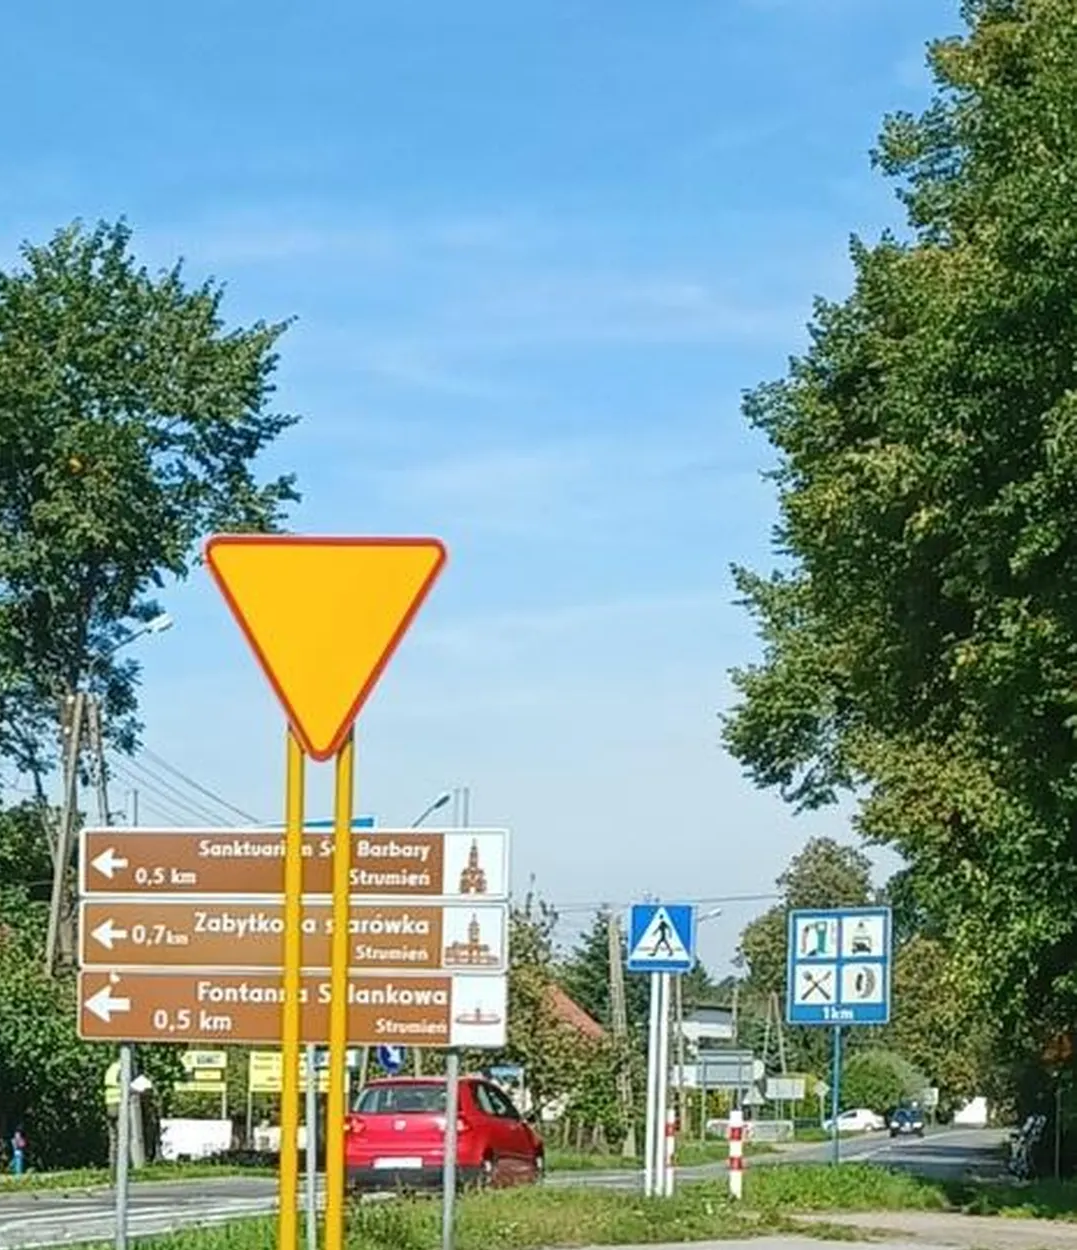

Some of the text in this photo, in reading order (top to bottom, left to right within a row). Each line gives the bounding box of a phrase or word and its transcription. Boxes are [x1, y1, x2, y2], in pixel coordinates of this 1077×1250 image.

[199, 839, 312, 858] Sanktuarim
[357, 839, 430, 861] Barbary
[135, 867, 197, 886] 0,5 km
[349, 867, 430, 886] Strumień
[194, 911, 429, 937] Zabytkoa sarówka
[318, 983, 447, 1006] Slankowa
[154, 1009, 232, 1032] 0,5 km
